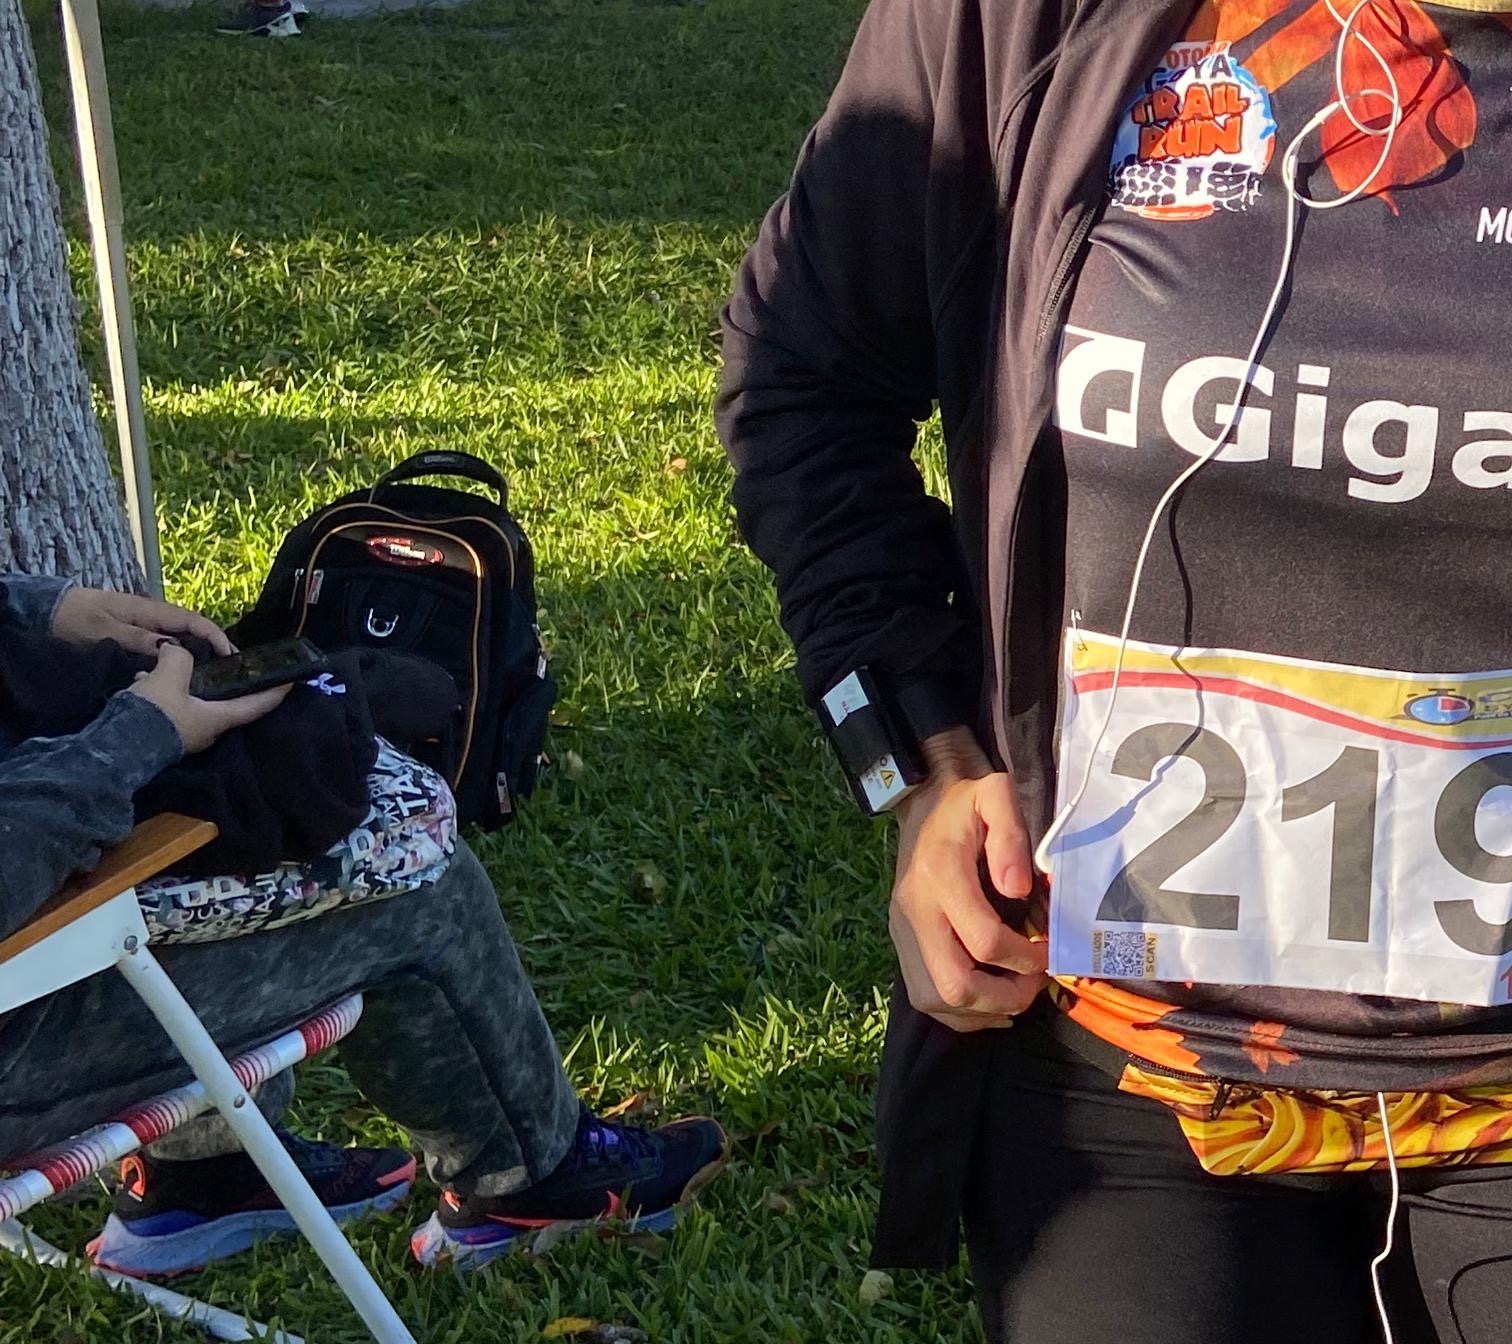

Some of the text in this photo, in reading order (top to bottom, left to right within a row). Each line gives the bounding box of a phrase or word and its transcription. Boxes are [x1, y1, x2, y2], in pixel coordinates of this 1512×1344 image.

[1132, 82, 1249, 124] TRAIL
[1138, 114, 1244, 160] RUN
[1146, 936, 1156, 973] SCAN
